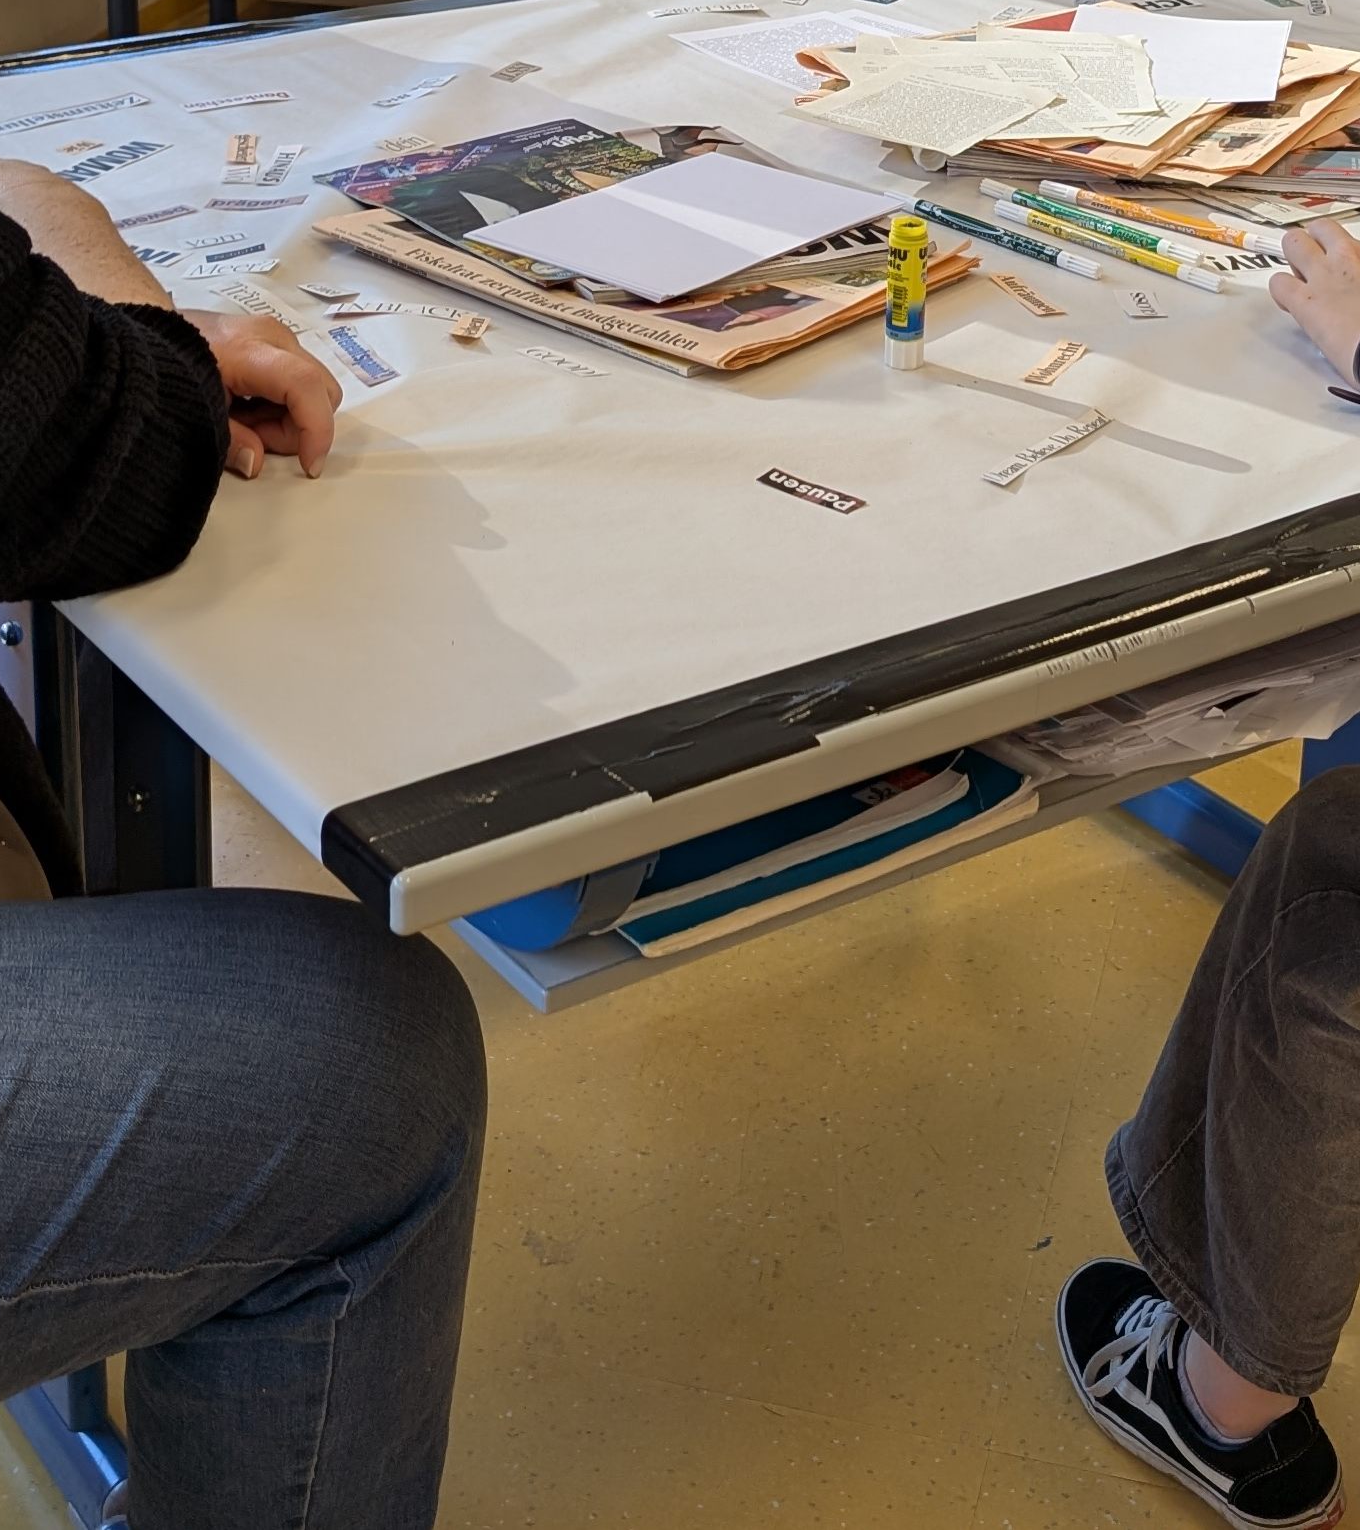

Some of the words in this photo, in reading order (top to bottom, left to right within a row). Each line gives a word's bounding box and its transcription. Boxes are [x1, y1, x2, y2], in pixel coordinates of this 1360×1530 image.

[183, 90, 291, 111] Dankeschön
[382, 133, 429, 156] dein
[269, 151, 298, 185] HINAUS
[185, 231, 247, 249] vom
[890, 246, 908, 262] HU
[404, 246, 484, 287] Fiskalrat
[478, 276, 574, 320] zerpflückt
[572, 304, 700, 352] Budgetzahlen
[996, 274, 1058, 315] Aufräumen
[335, 301, 370, 313] IN
[1026, 340, 1083, 383] Wohnrecht
[982, 462, 1028, 483] Dream.
[768, 470, 857, 513] Pausen
